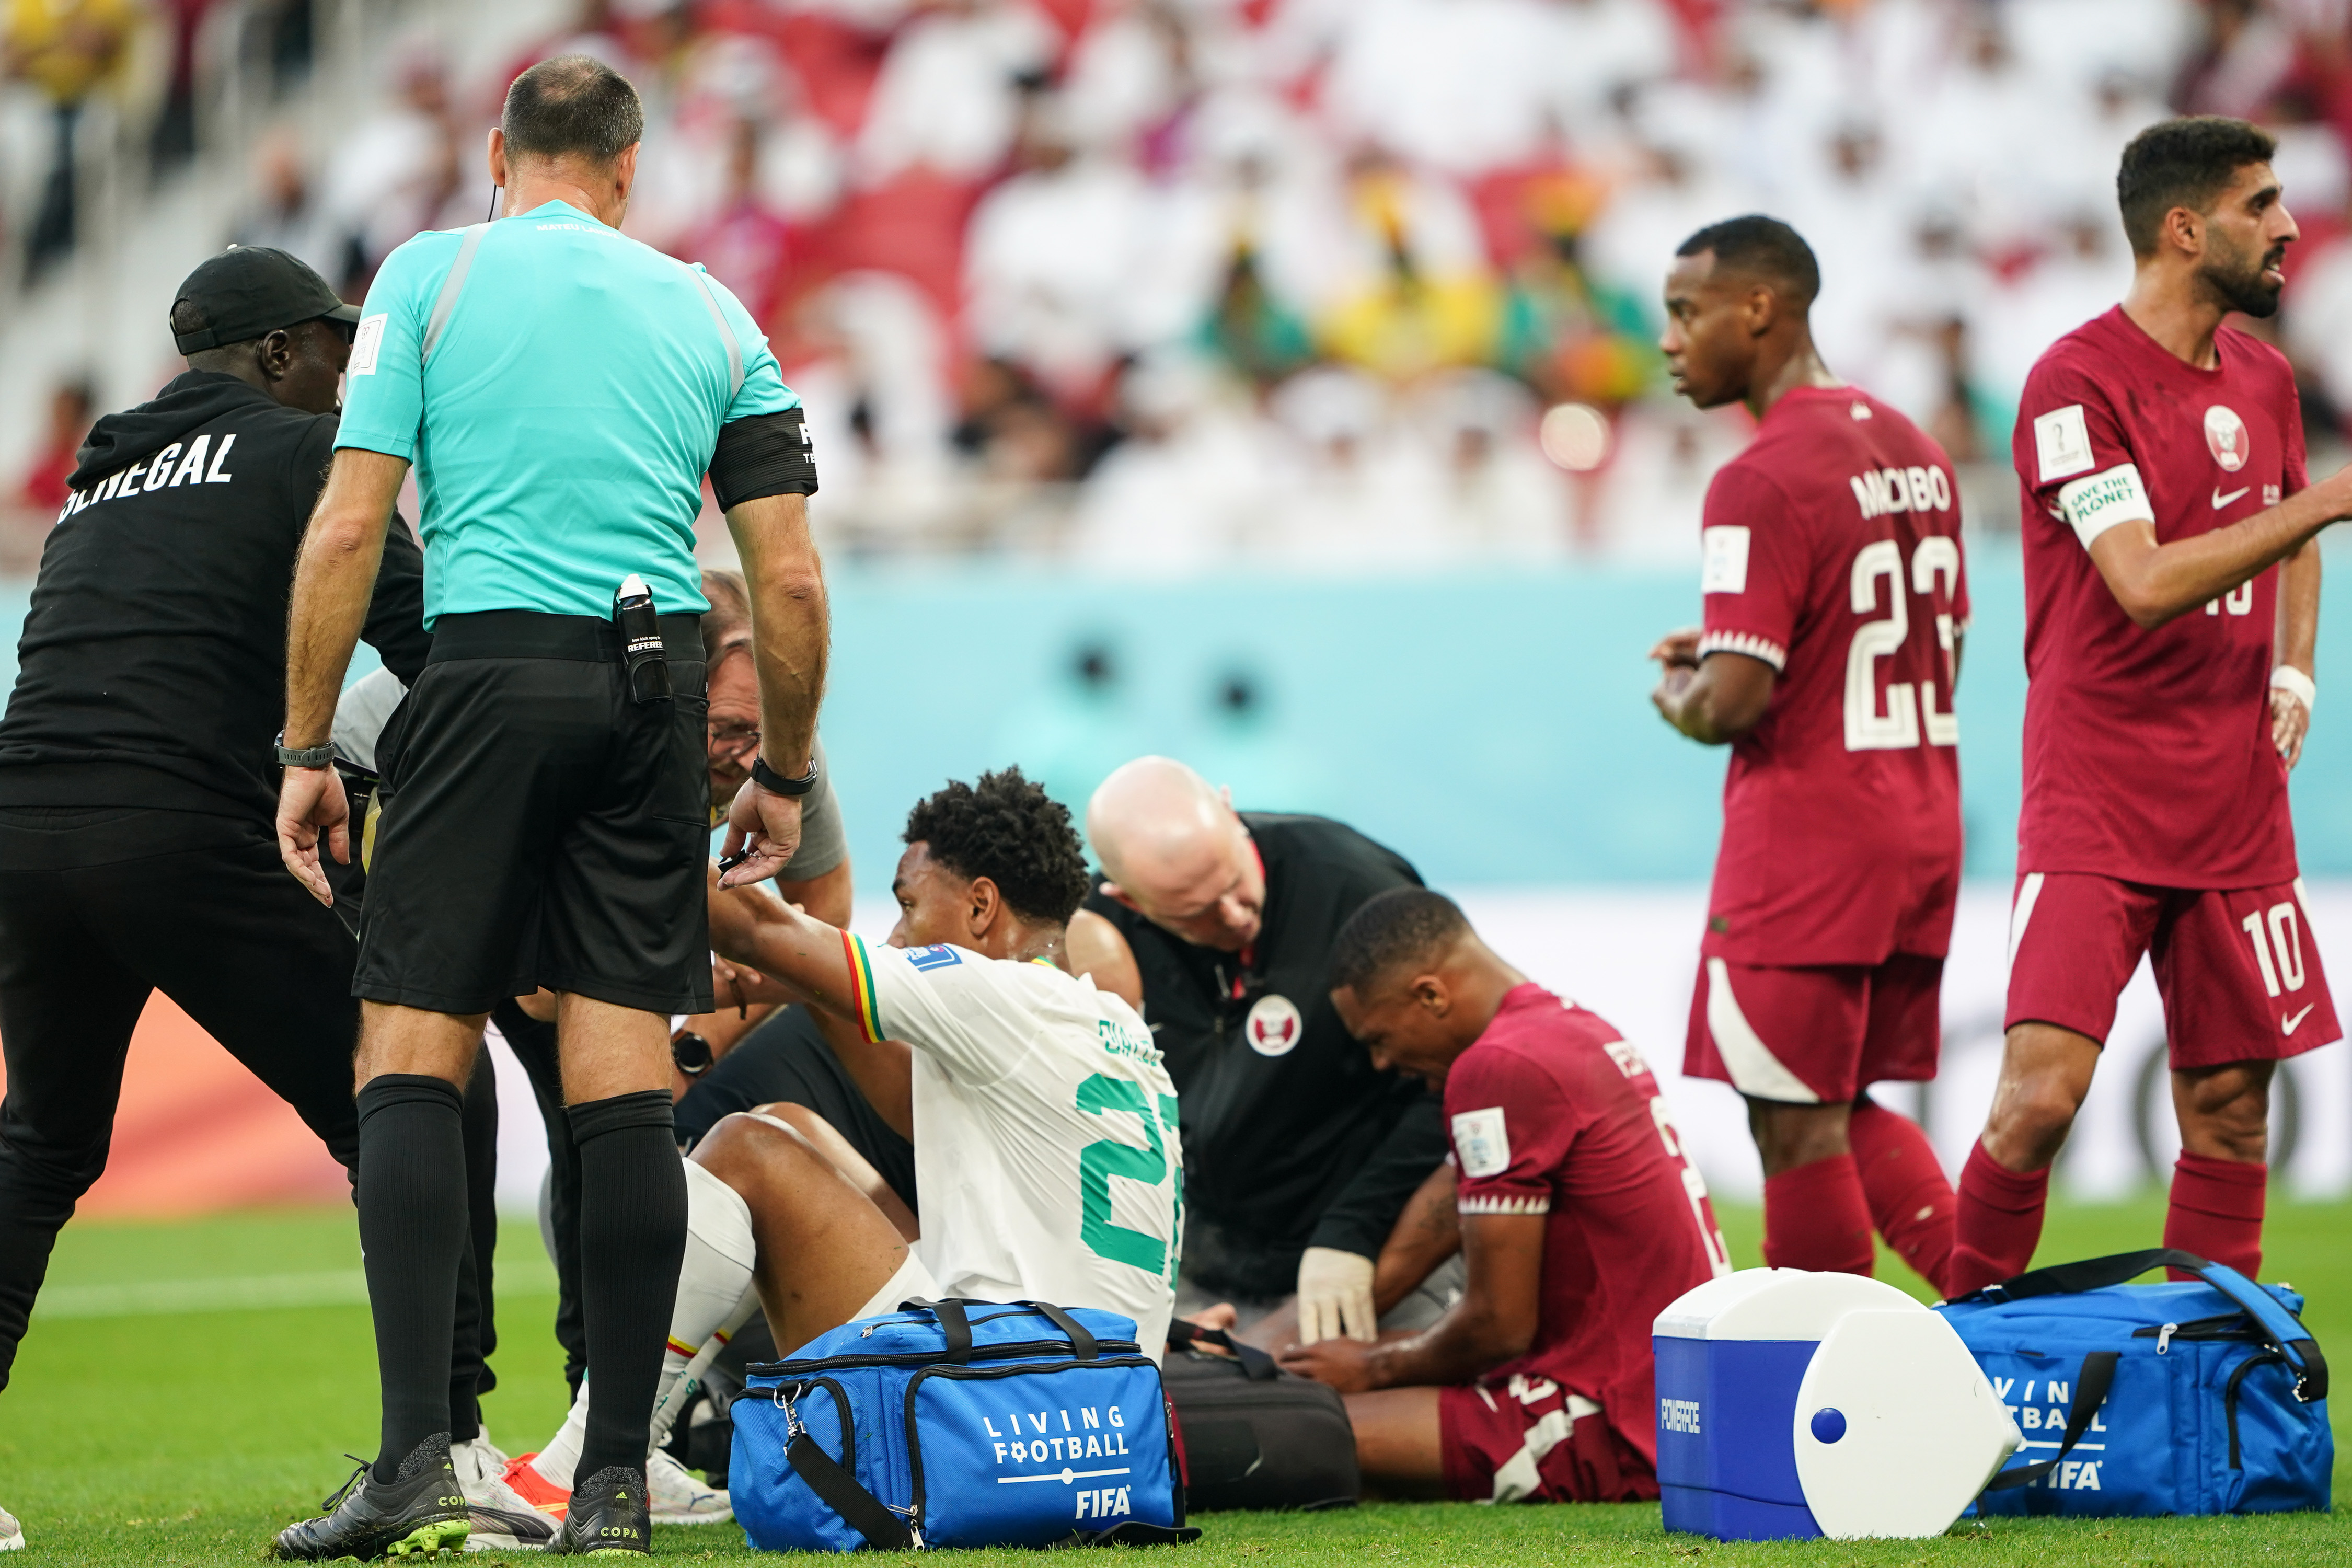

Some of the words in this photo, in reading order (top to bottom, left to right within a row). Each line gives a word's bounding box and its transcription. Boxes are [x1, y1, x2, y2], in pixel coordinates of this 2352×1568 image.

[2071, 484, 2100, 509] SAVE
[2102, 476, 2130, 490] THE
[1844, 536, 1960, 752] 23
[2242, 901, 2305, 998] 10
[983, 1406, 1125, 1437] LIVING
[1661, 1398, 1701, 1434] POWERADE
[993, 1433, 1129, 1464] FOOTBALL
[438, 1496, 467, 1507] COP
[1075, 1486, 1131, 1519] FIFA
[601, 1527, 639, 1539] COPA
